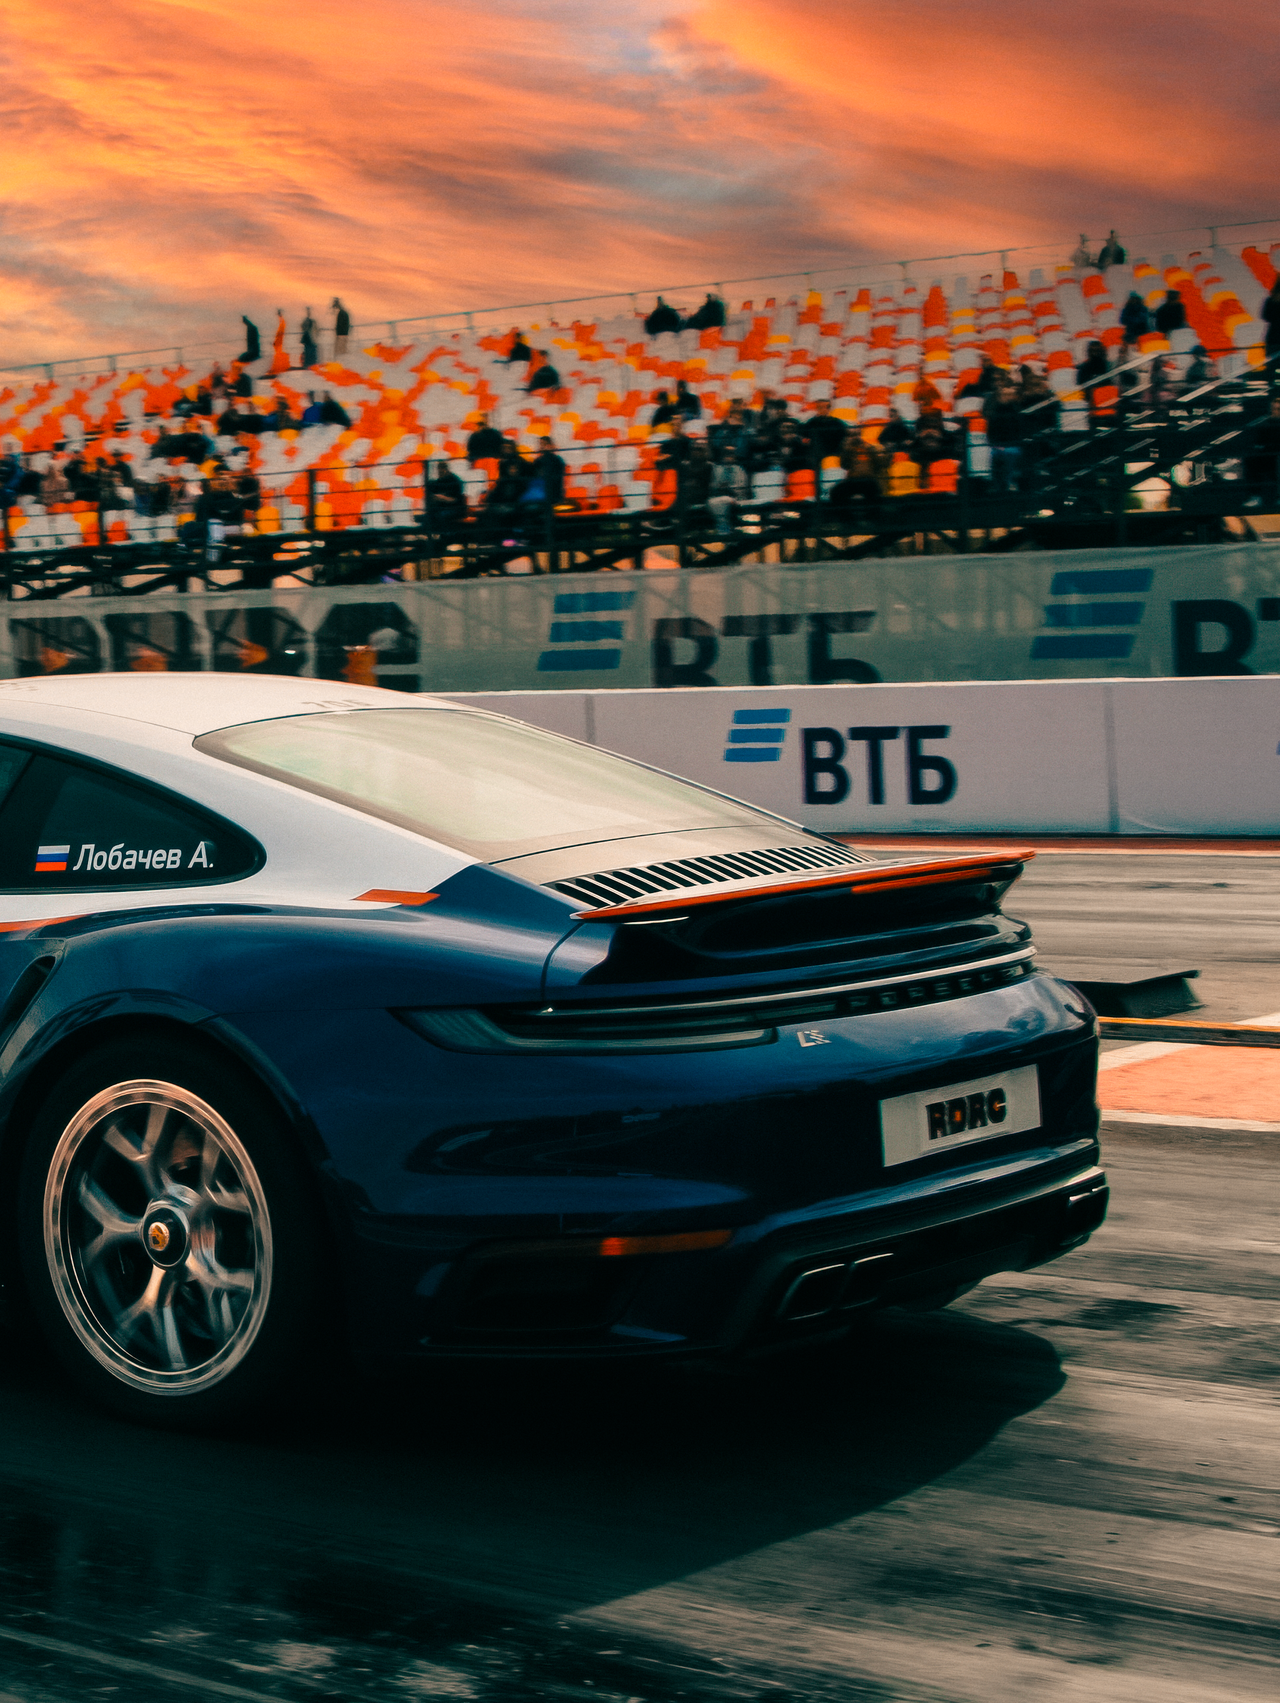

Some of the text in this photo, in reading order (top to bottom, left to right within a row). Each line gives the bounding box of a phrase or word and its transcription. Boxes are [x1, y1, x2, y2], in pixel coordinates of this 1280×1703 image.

[801, 725, 957, 805] ВТБ
[73, 840, 215, 871] Лобачев А.
[925, 1087, 1007, 1140] RDRC
